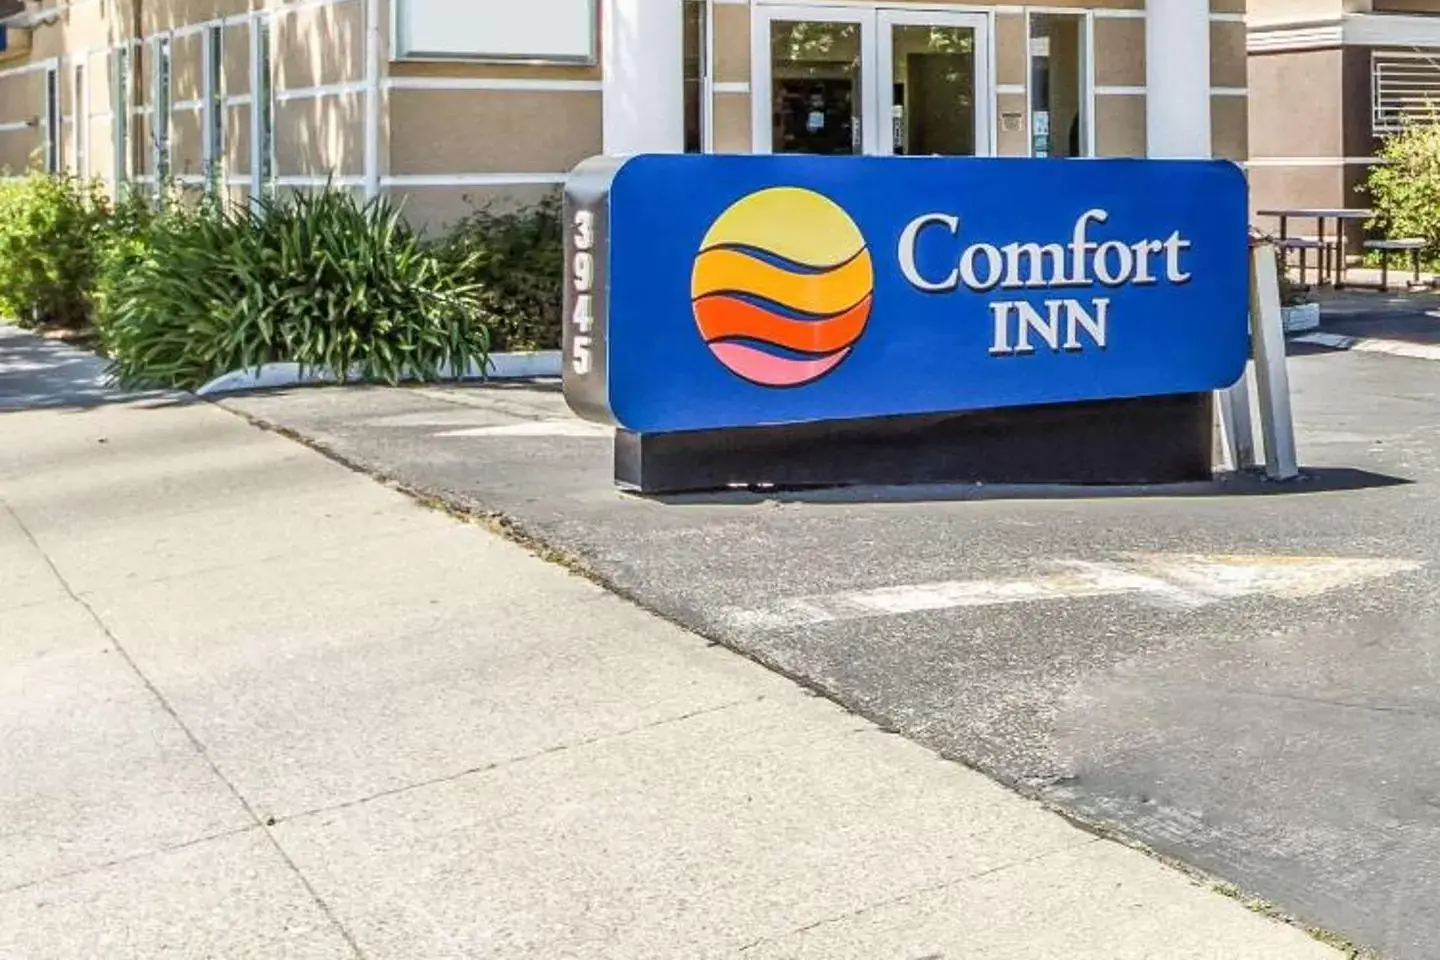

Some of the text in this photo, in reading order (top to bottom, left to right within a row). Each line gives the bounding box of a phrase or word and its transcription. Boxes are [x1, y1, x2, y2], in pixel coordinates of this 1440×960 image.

[897, 208, 1191, 292] Comfort
[573, 210, 594, 375] 3945
[988, 297, 1111, 354] INN
